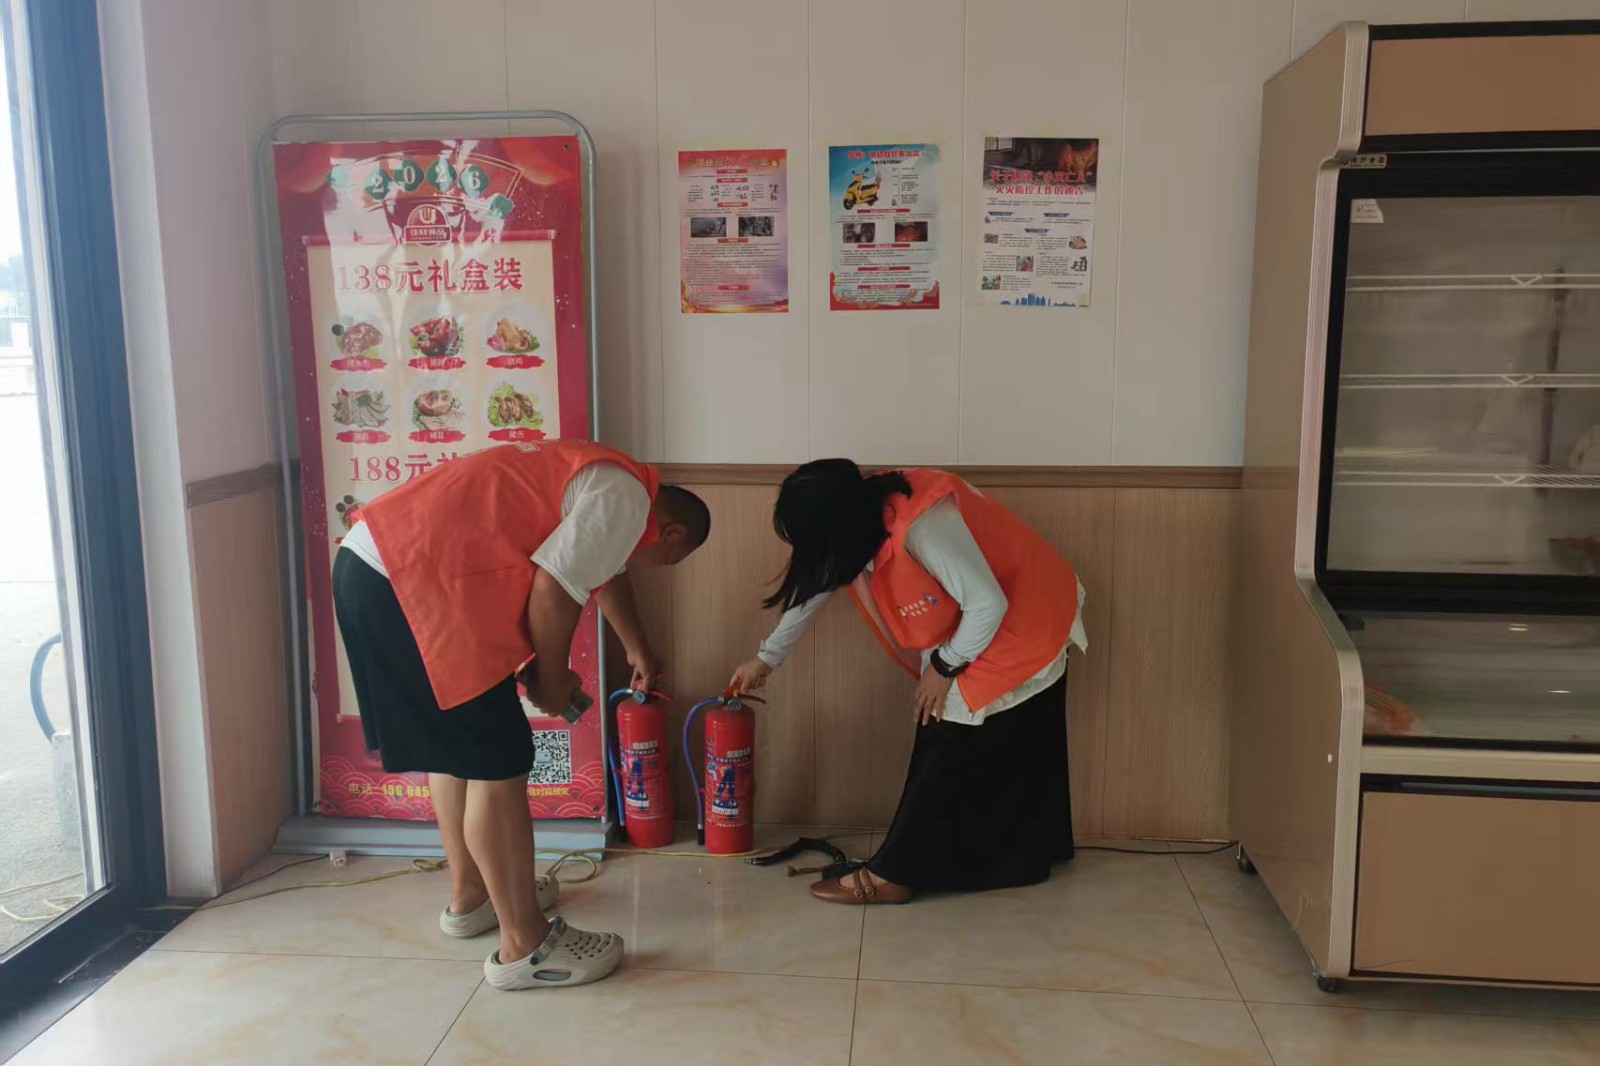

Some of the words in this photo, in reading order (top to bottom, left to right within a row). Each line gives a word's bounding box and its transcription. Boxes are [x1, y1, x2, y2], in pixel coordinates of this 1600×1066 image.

[372, 164, 482, 193] 2026
[338, 257, 523, 293] 138元礼盒装
